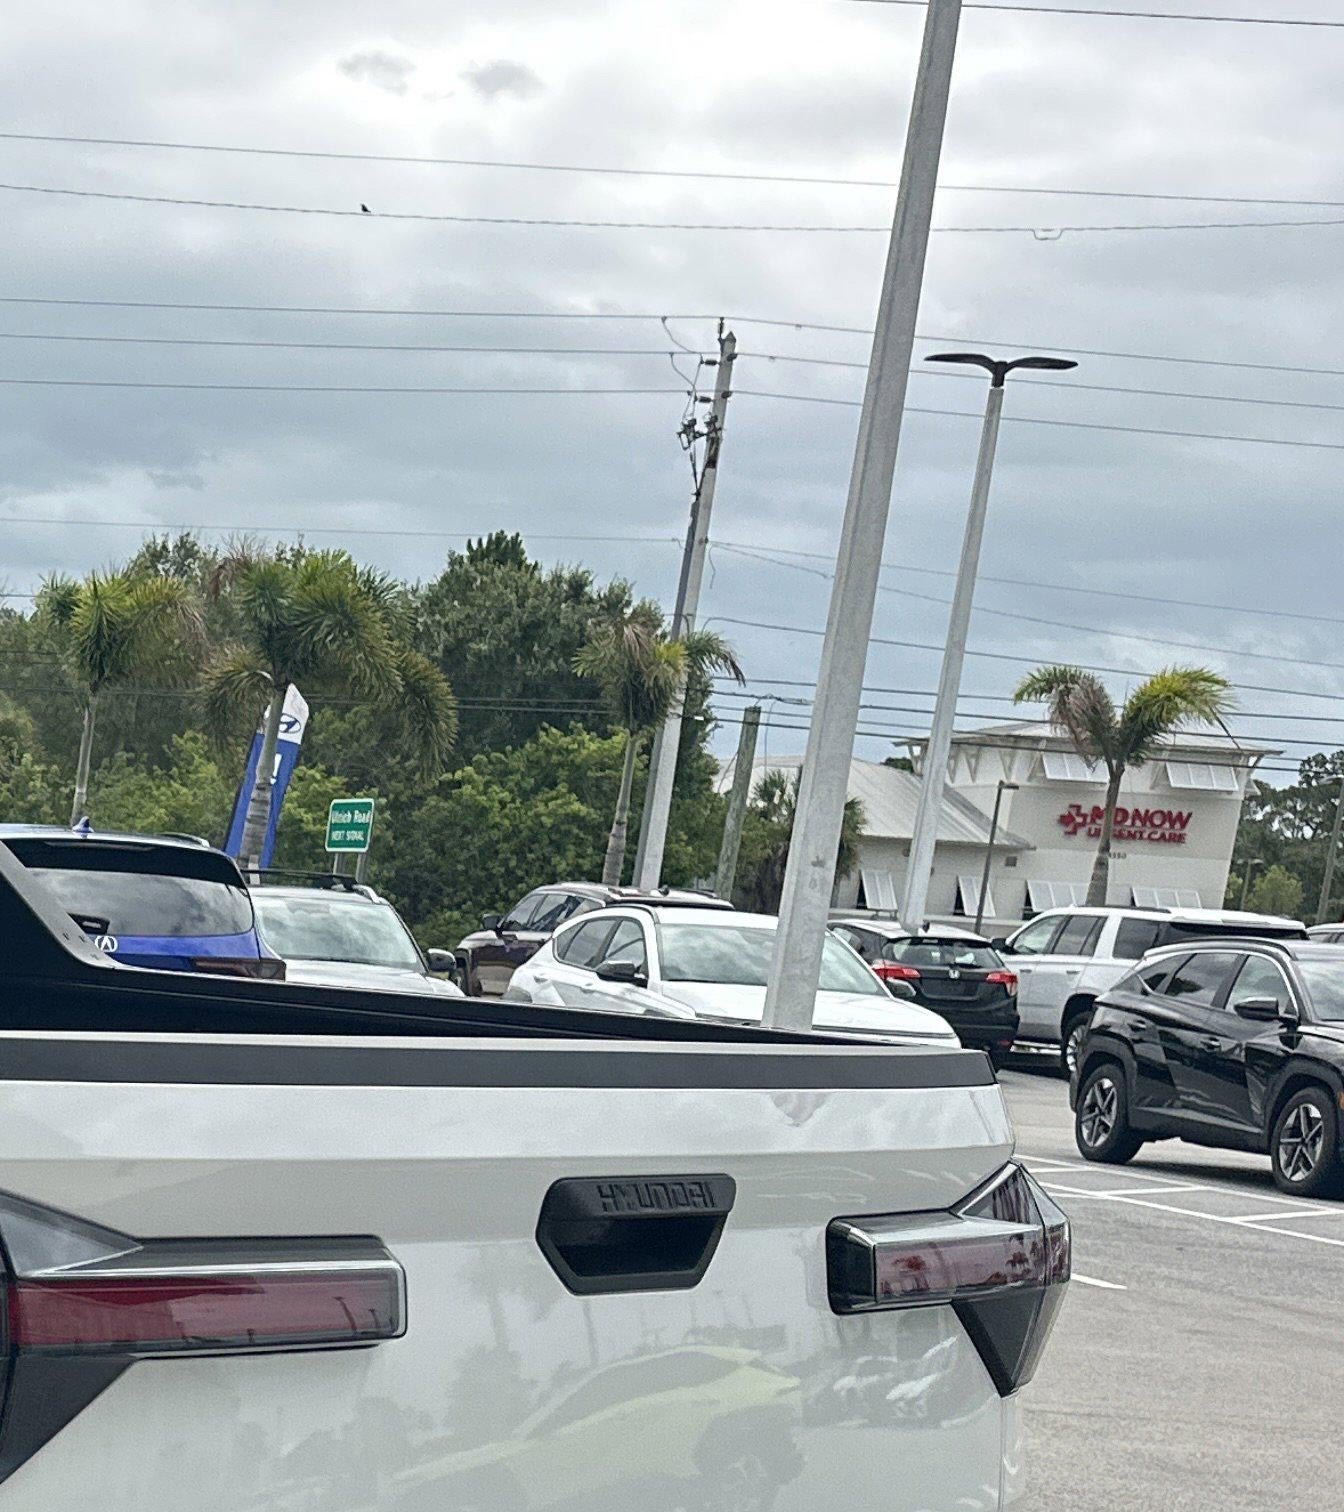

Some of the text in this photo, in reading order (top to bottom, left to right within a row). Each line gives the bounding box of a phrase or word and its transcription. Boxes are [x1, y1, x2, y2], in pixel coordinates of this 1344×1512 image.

[1130, 808, 1193, 830] NOW
[1146, 830, 1187, 844] CARE
[597, 1181, 715, 1213] HYUNDAI
